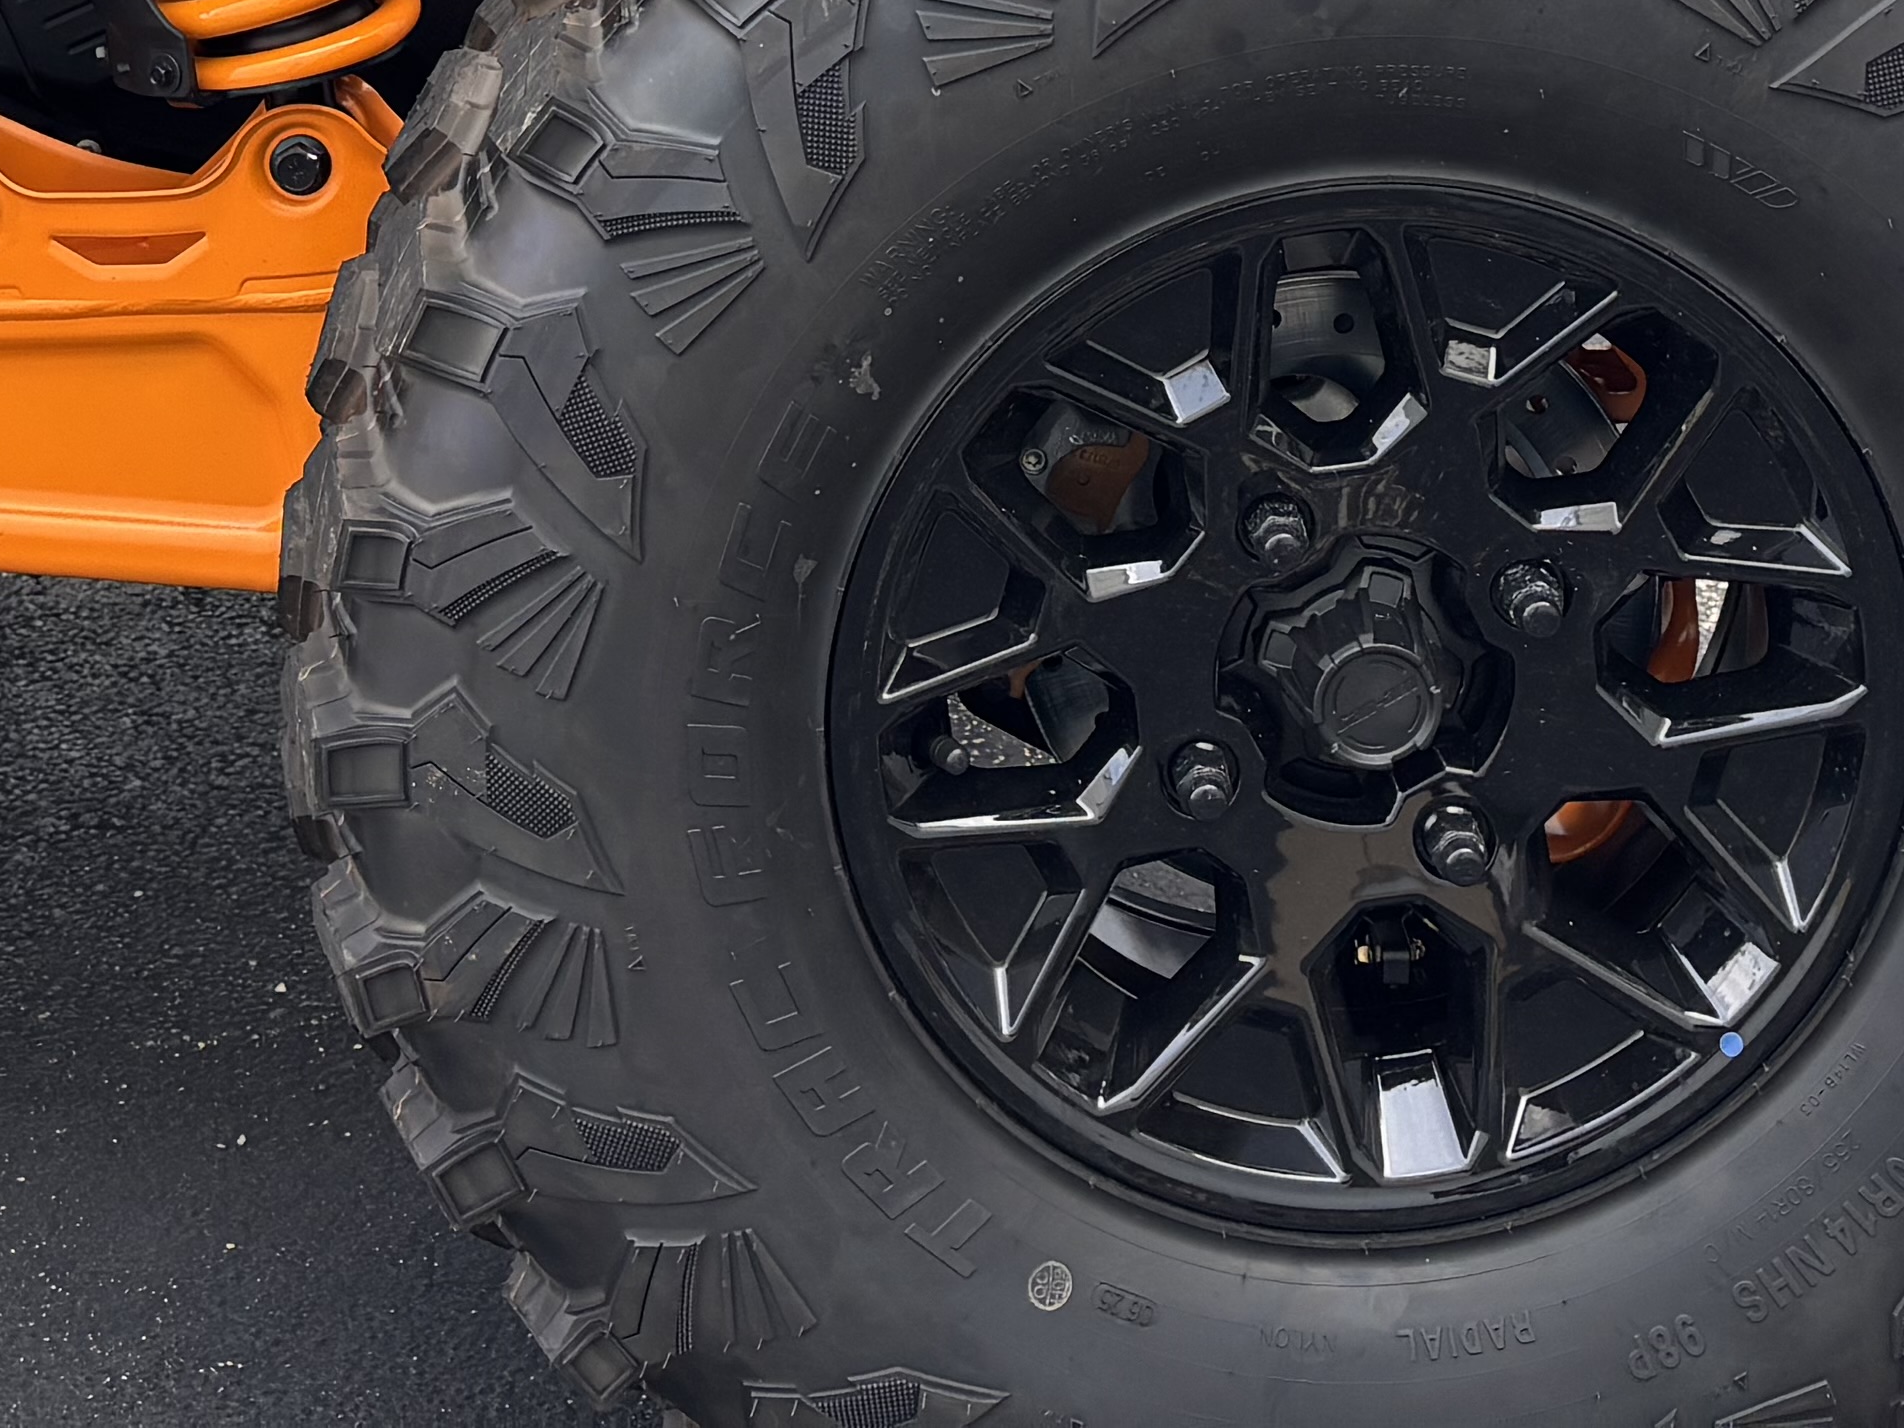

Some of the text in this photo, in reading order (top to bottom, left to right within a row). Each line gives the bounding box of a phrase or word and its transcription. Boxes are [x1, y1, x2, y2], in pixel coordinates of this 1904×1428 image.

[1721, 1228, 1840, 1335] NHS
[1393, 1306, 1539, 1365] RADIAL
[1612, 1304, 1713, 1387] 98P
